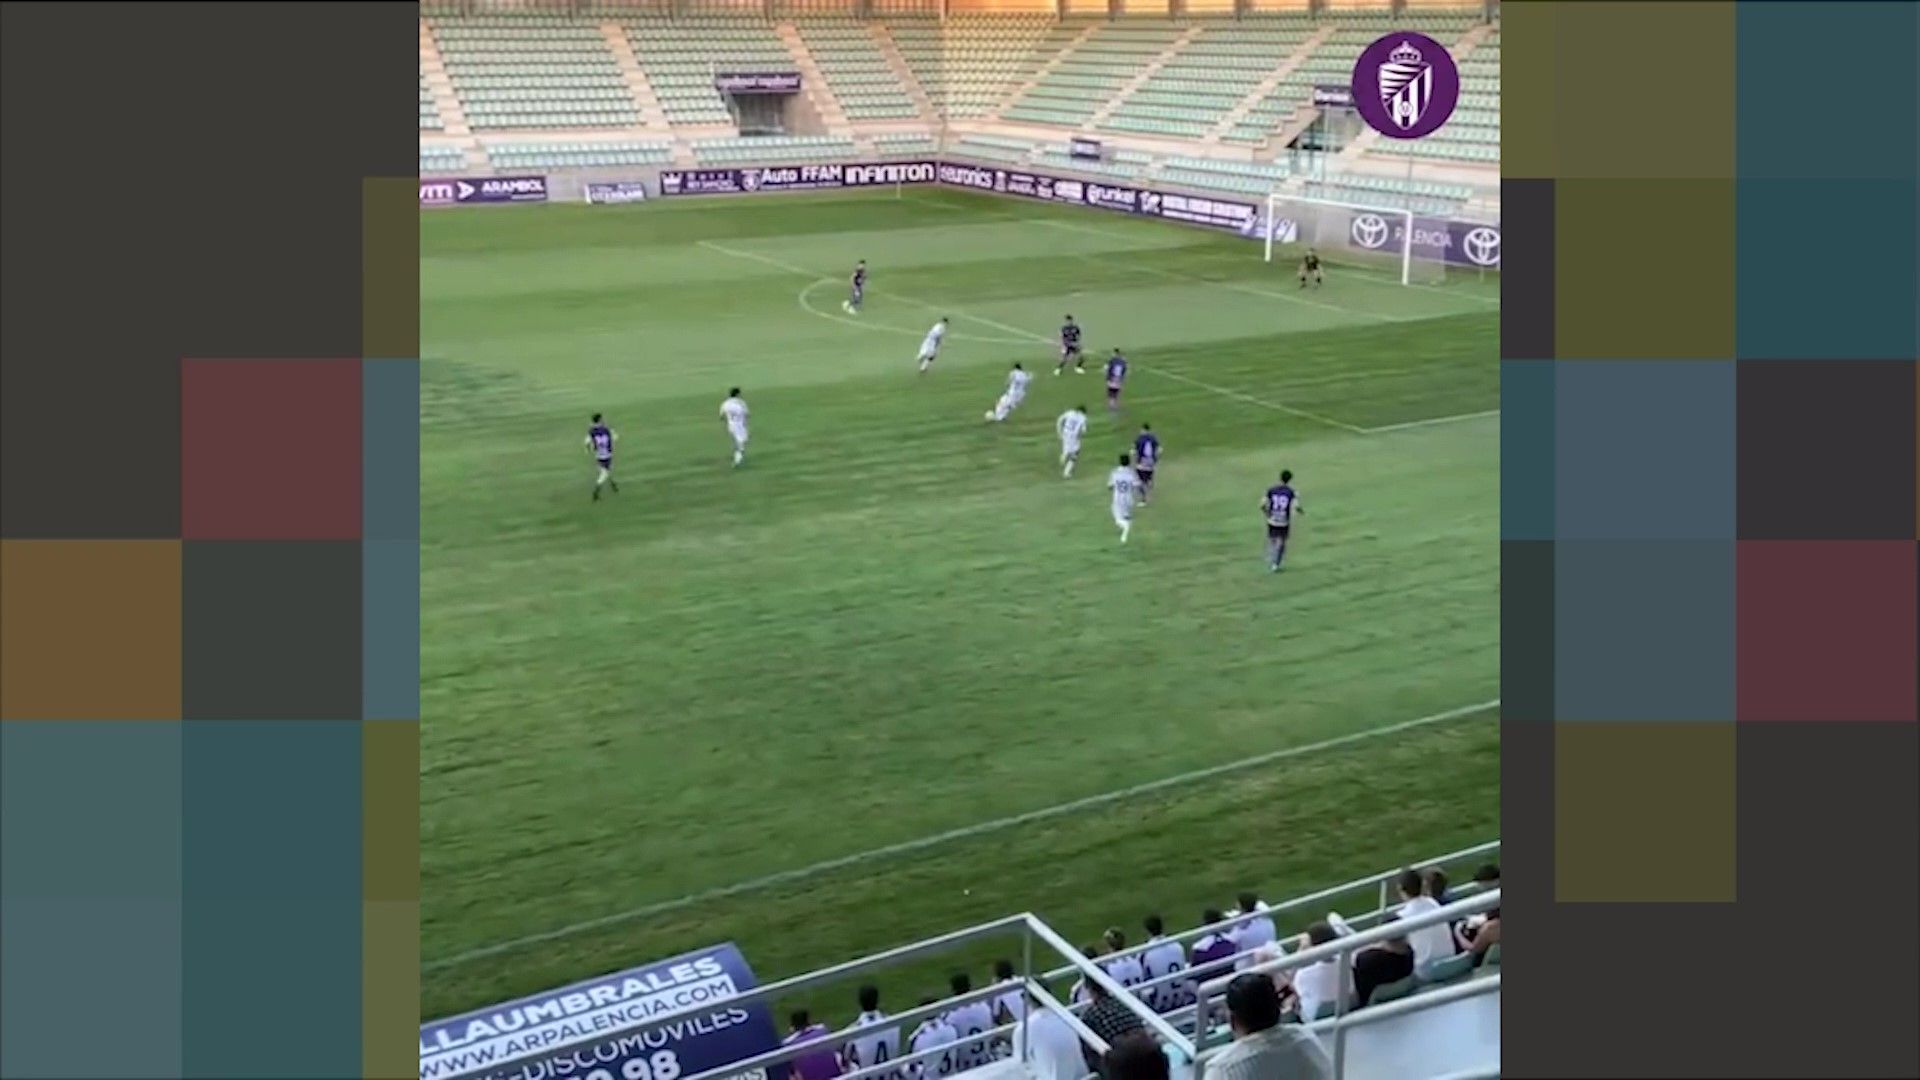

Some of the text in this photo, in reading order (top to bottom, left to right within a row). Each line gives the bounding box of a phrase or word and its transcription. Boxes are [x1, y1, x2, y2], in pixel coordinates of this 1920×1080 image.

[761, 165, 843, 184] Auto FFAM
[481, 180, 544, 194] ARAMBOL
[1271, 493, 1289, 511] 19
